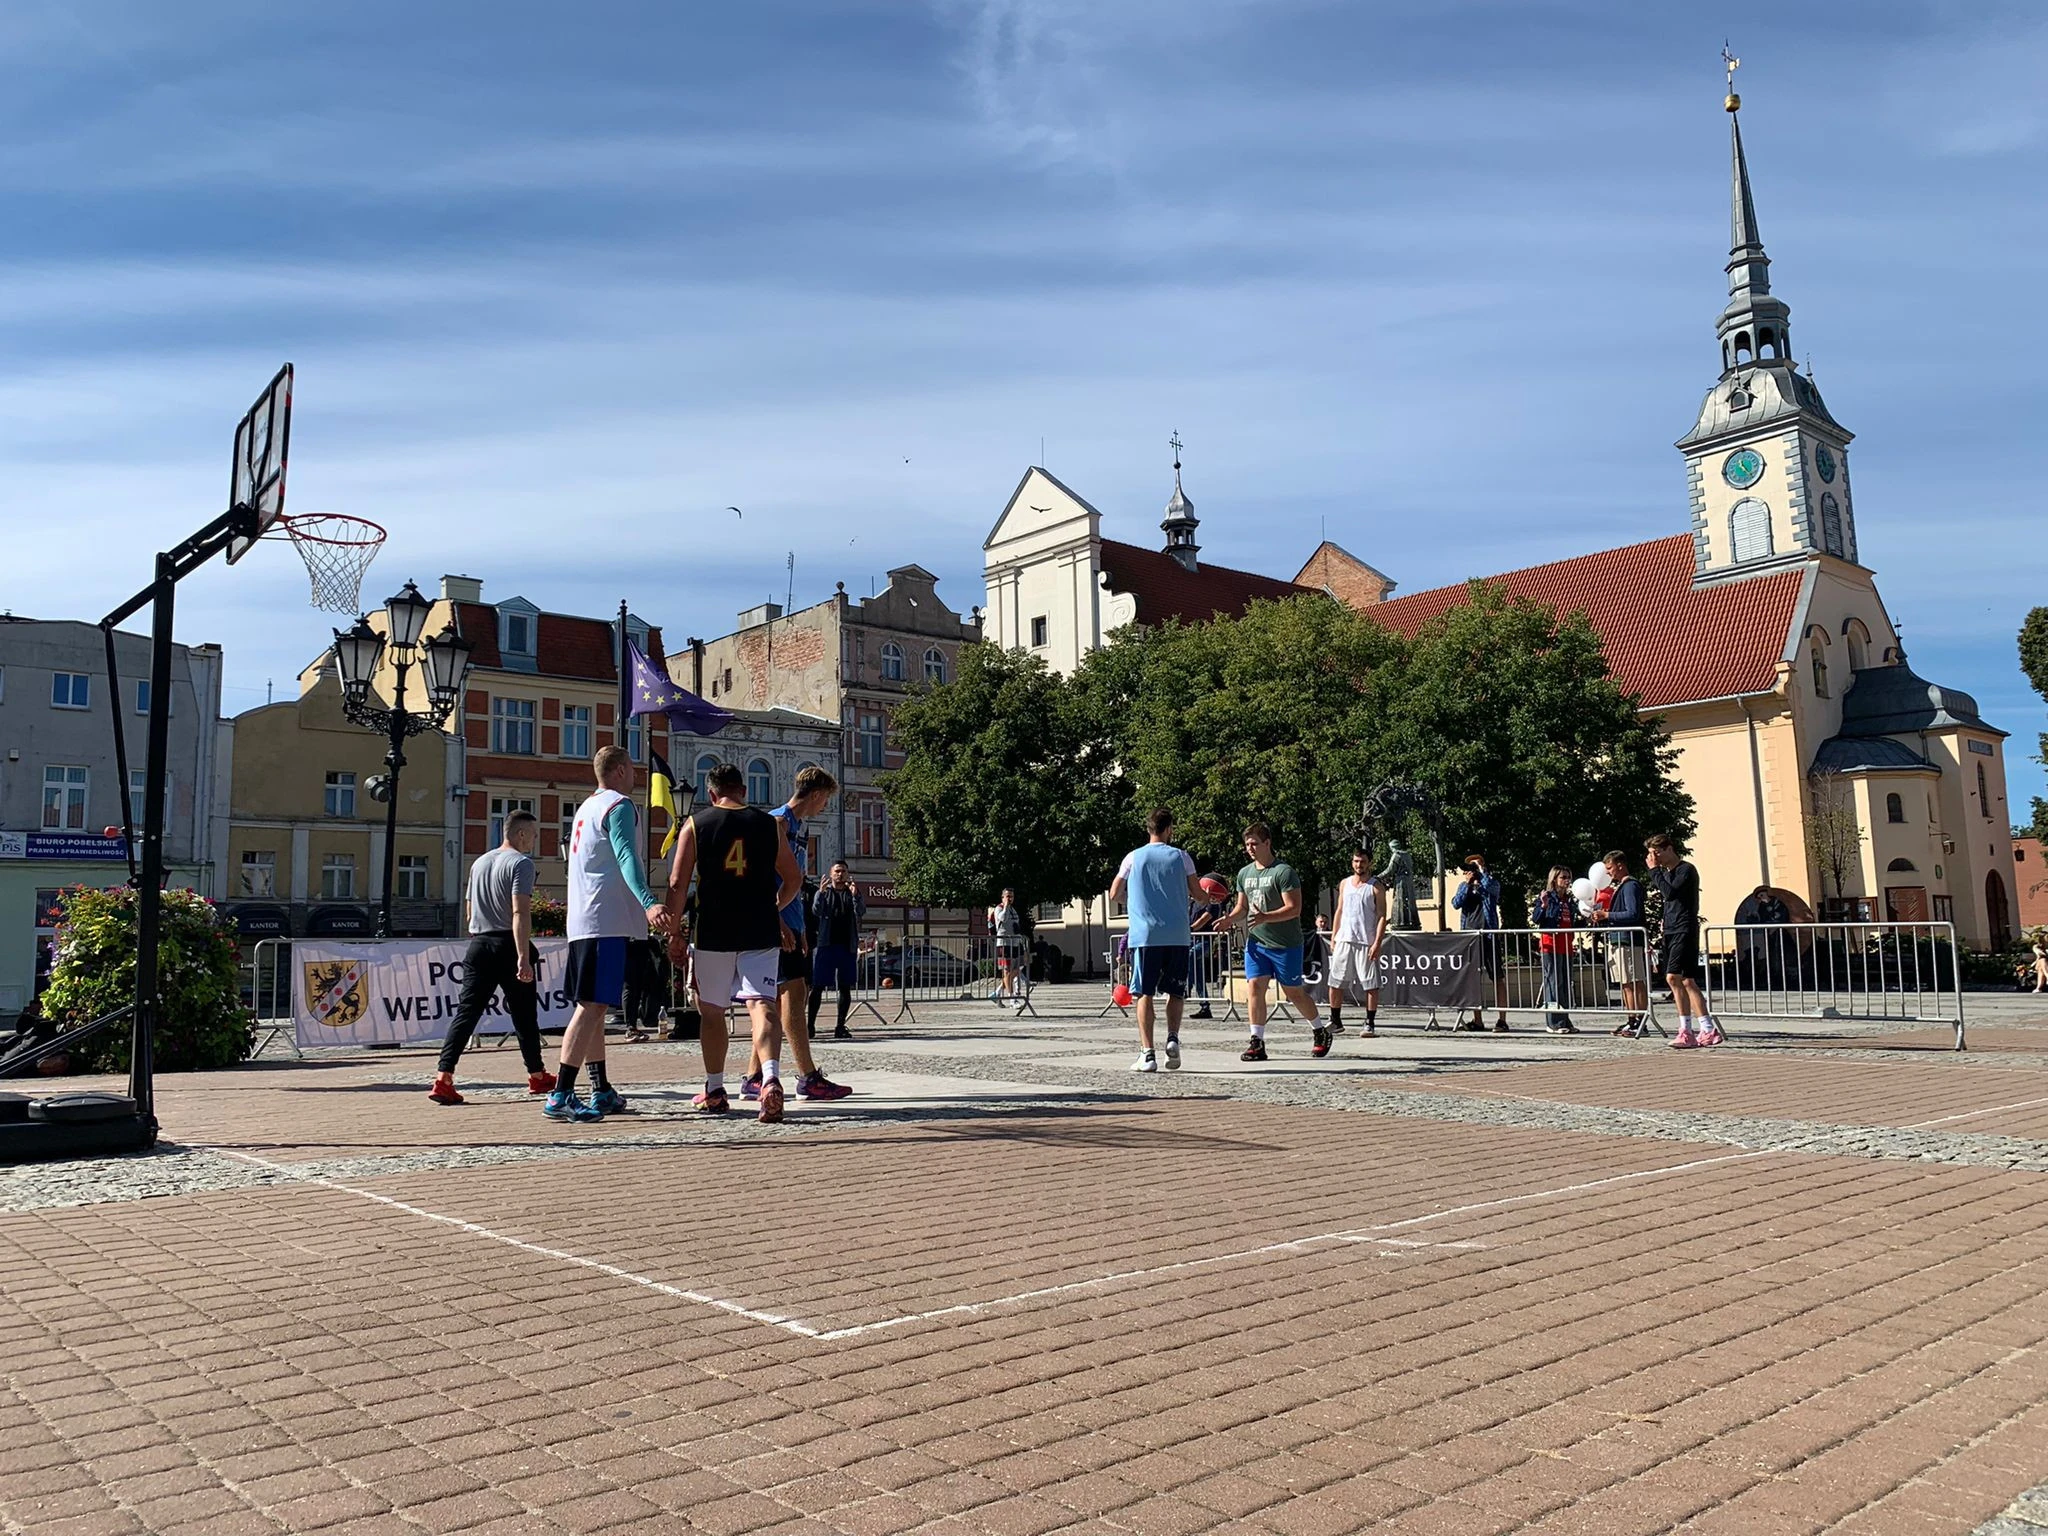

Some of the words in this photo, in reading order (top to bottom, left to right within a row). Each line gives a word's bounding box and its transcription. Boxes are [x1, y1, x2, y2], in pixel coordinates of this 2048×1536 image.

[725, 839, 747, 877] 4
[868, 886, 898, 899] Księg
[1379, 954, 1463, 970] SPLOTU
[1396, 976, 1441, 986] MADE
